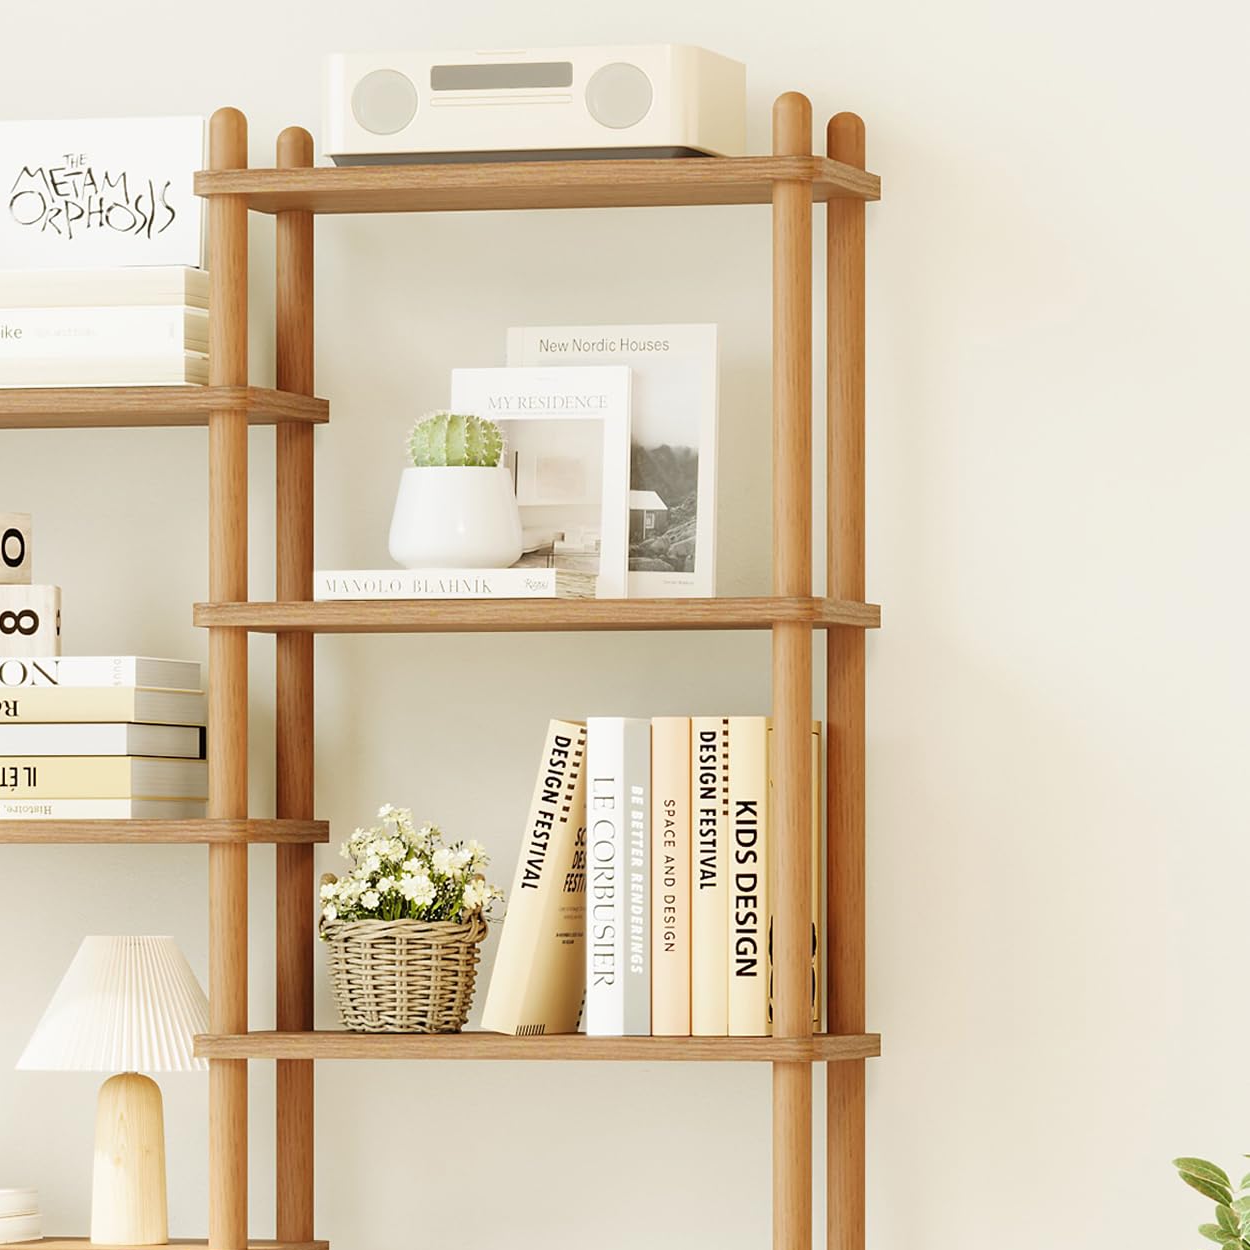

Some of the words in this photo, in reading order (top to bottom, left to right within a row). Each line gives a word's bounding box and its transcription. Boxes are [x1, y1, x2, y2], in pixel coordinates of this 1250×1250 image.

[63, 153, 87, 169] THE
[539, 339, 569, 353] New
[572, 338, 617, 352] Nordic
[620, 337, 670, 352] Houses
[488, 396, 514, 409] MY
[518, 395, 608, 409] RESIDENCE
[326, 579, 402, 594] MANOLO
[25, 766, 37, 787] IL
[541, 735, 572, 805] DESIGN
[593, 777, 615, 811] LE
[700, 731, 717, 800] DESIGN
[631, 786, 644, 805] BE
[664, 799, 676, 848] SPACE
[521, 810, 554, 890] FESTIVAL
[630, 809, 644, 868] BETTER
[700, 808, 717, 890] FESTIVAL
[735, 801, 758, 865] KIDS
[664, 854, 676, 888] AND
[592, 819, 616, 987] CORBUSIER
[630, 871, 644, 975] RENDERINGS
[664, 894, 676, 952] DESIGN
[735, 873, 758, 977] DESIGN
